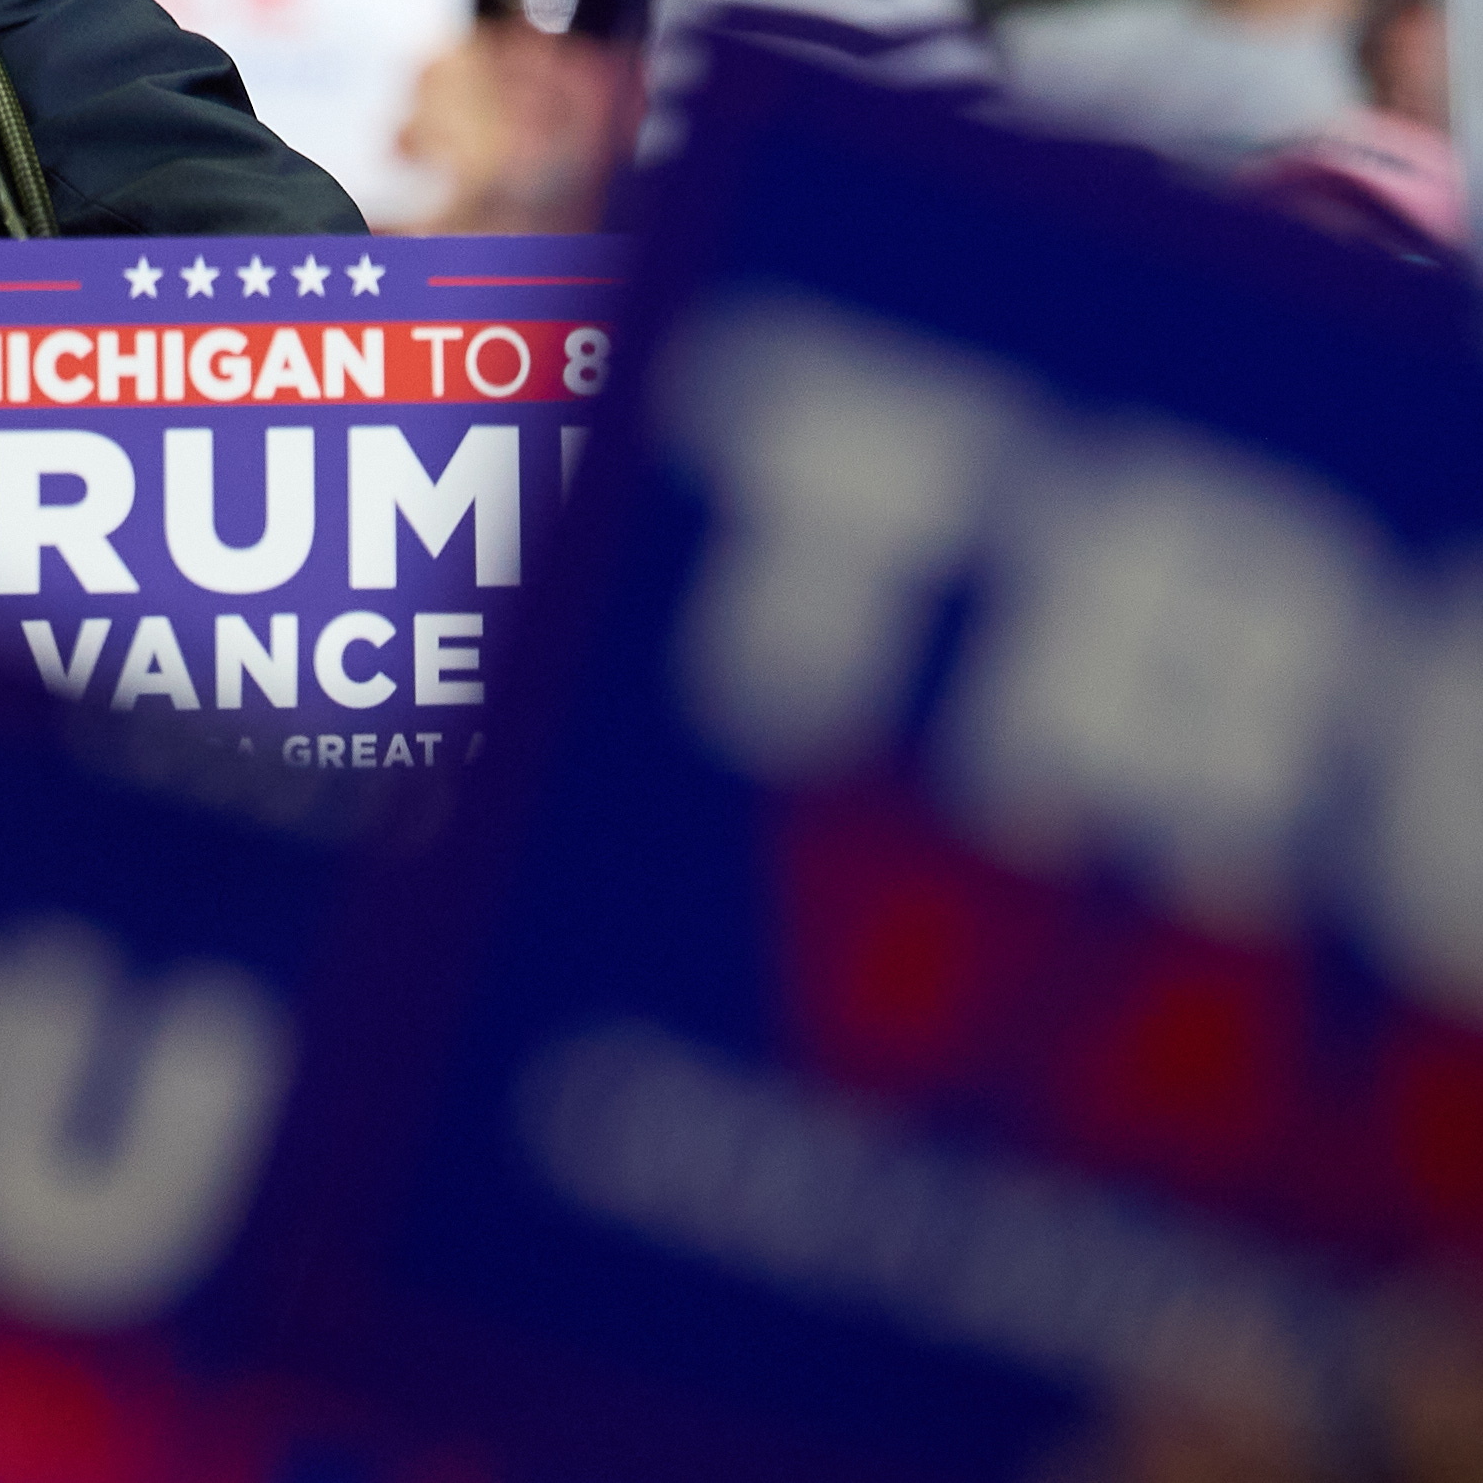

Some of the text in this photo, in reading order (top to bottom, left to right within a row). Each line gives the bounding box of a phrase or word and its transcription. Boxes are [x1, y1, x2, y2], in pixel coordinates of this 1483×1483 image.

[410, 326, 530, 398] TO
[19, 609, 485, 711] VANCE
[281, 731, 442, 768] GREAT
